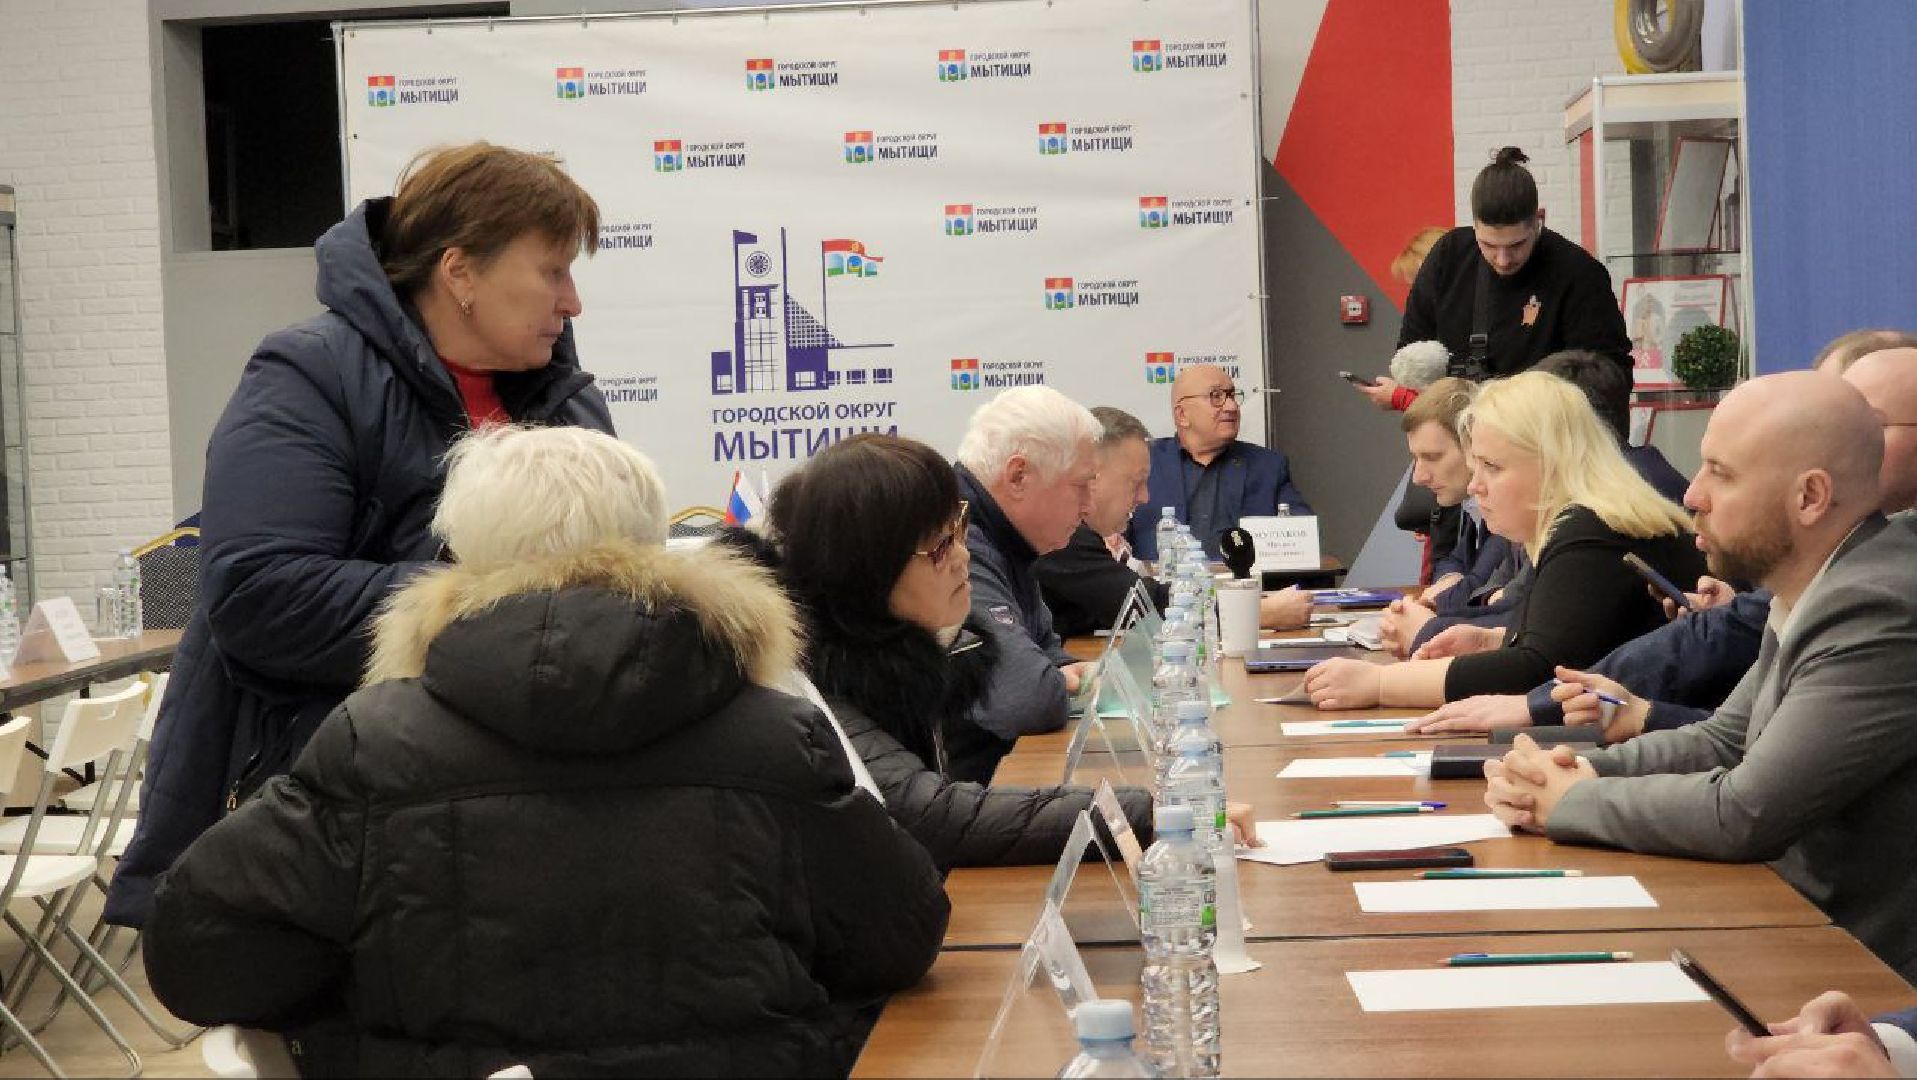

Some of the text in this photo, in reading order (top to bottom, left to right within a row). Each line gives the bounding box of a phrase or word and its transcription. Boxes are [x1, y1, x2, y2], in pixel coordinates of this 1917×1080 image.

[1166, 54, 1227, 68] МЫТИЩИ
[970, 63, 1031, 78] МЫТИЩИ
[589, 81, 647, 95] МЫТИЩИ
[779, 73, 838, 88] МЫТИЩИ
[400, 89, 458, 104] МЫТИЩИ
[1072, 137, 1132, 152] МЫТИЩИ
[878, 145, 938, 160] МЫТИЩИ
[687, 154, 745, 169] МЫТИЩИ
[978, 218, 1037, 233] МЫТИЩИ
[1173, 211, 1233, 225] МЫТИЩИ
[1078, 292, 1139, 307] МЫТИЩИ
[713, 402, 897, 425] ГОРОДСКОЙ ОКРУГ
[714, 425, 897, 462] МЫТИ
